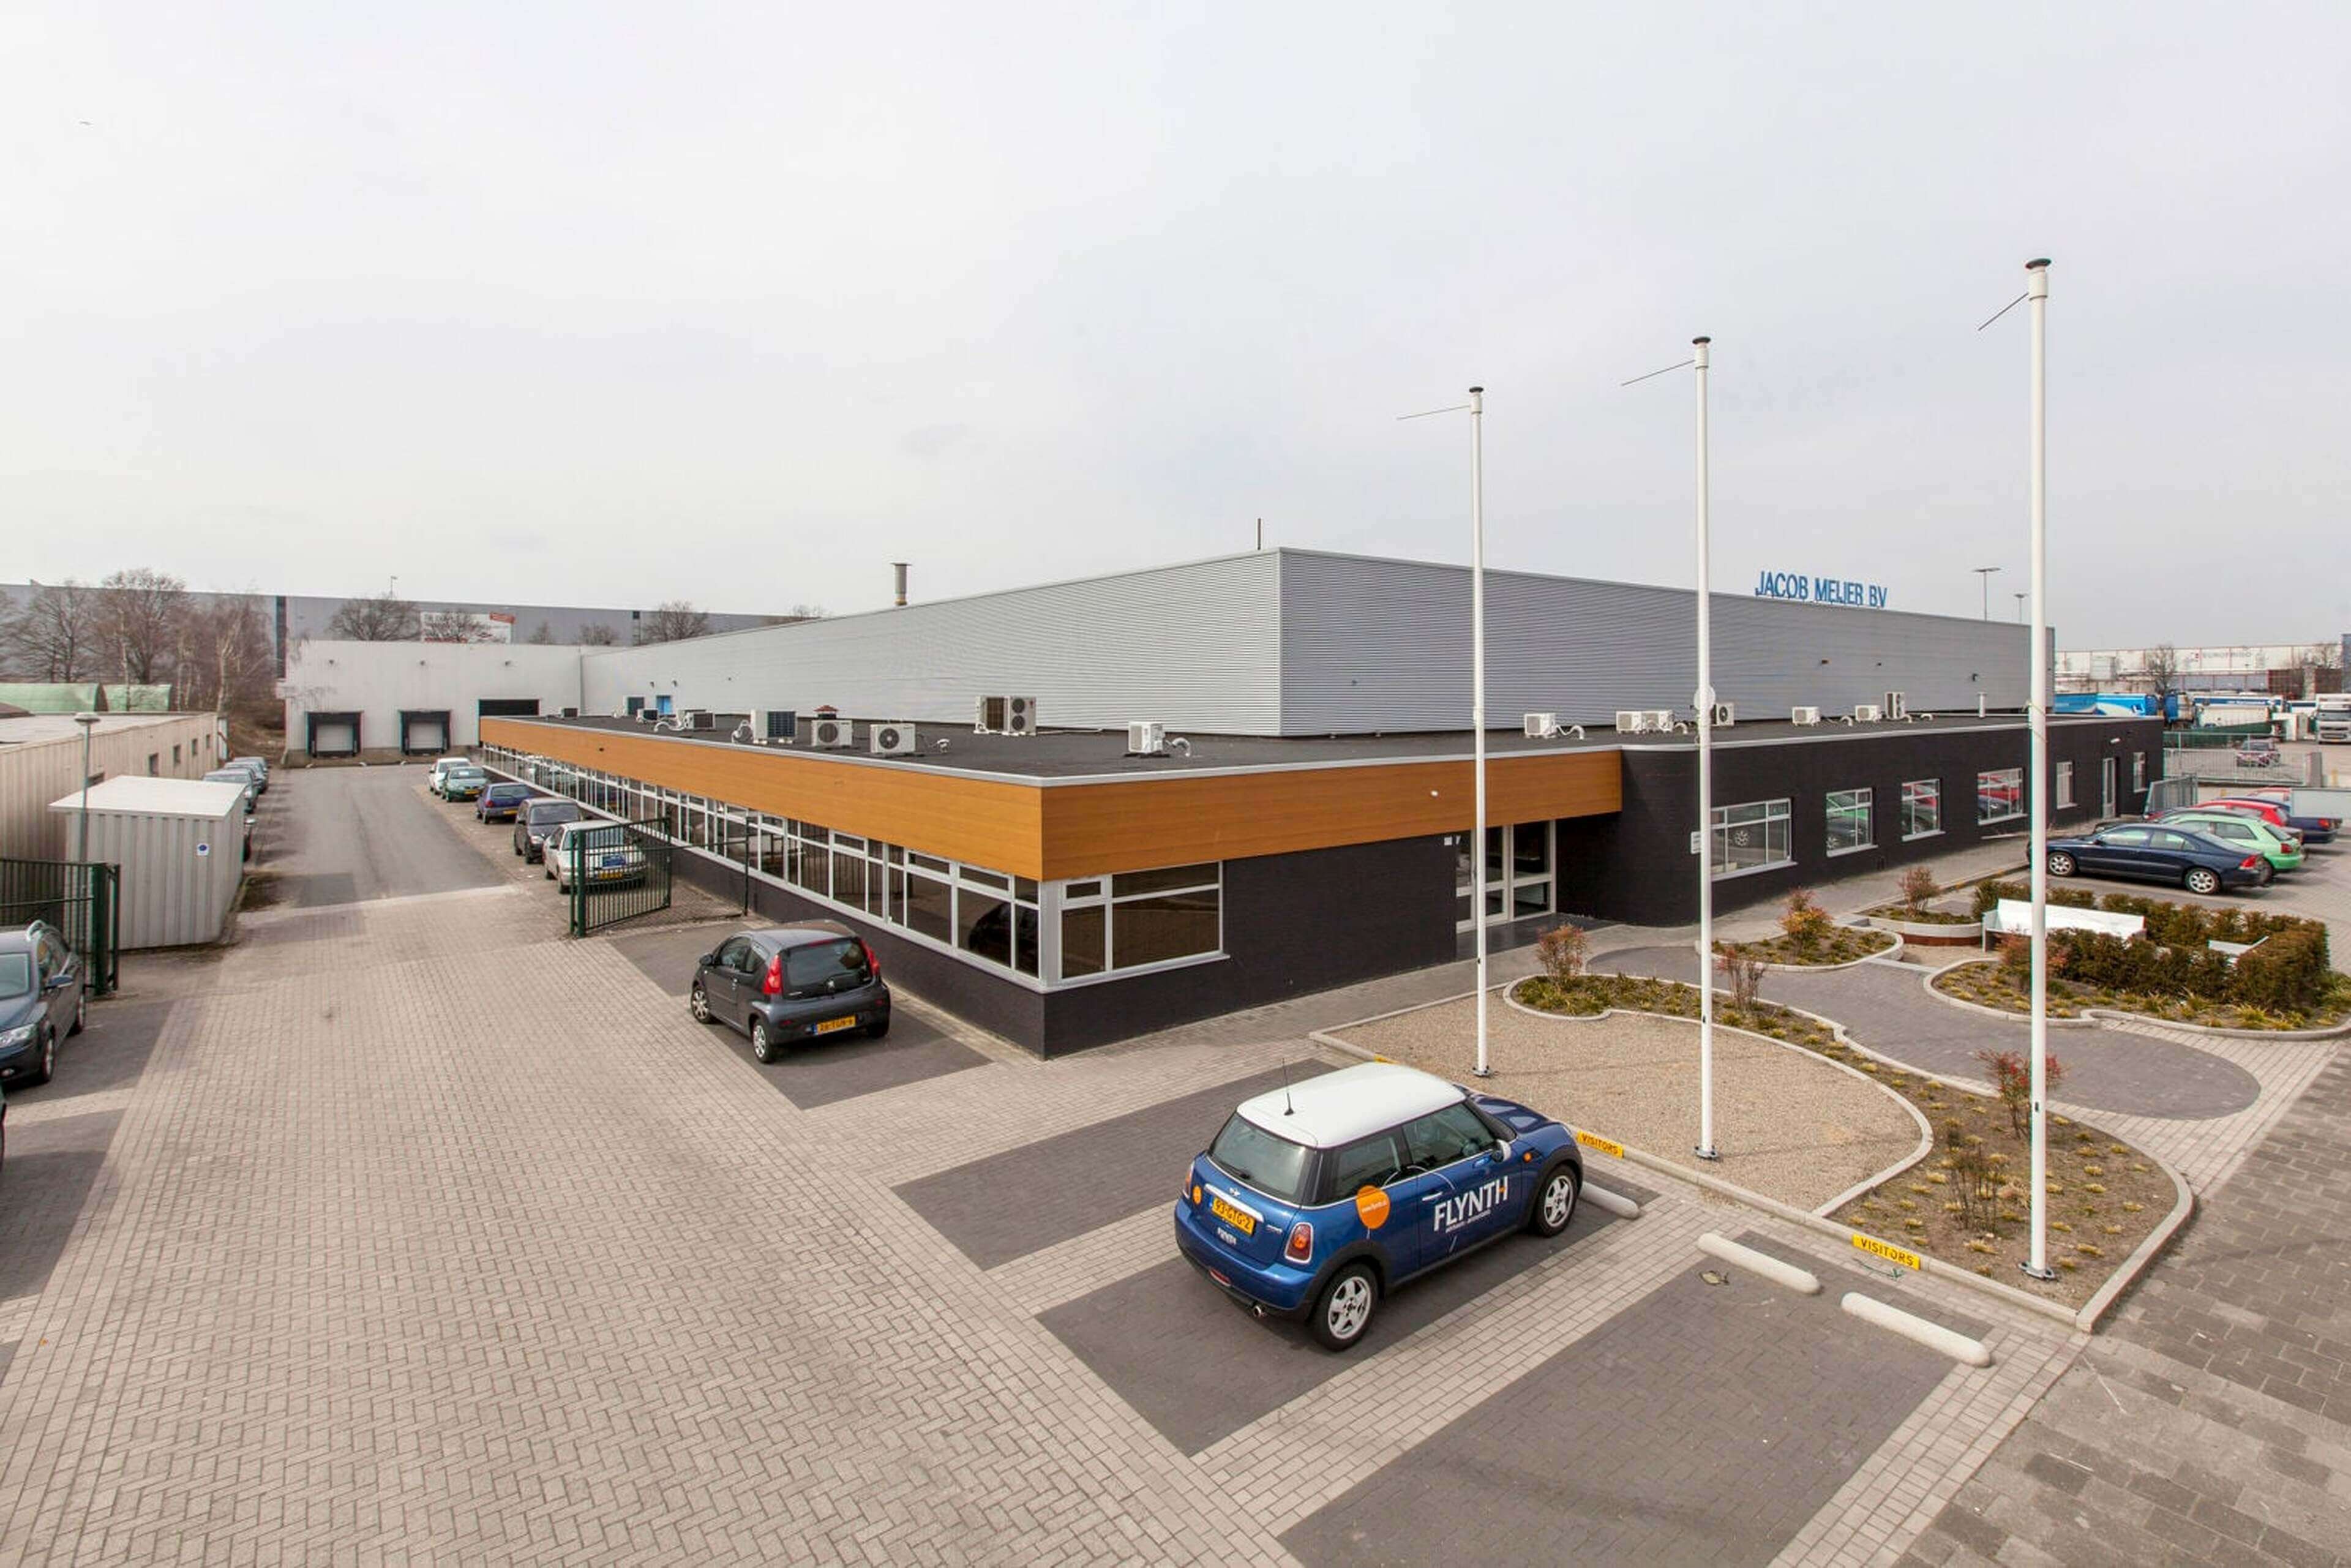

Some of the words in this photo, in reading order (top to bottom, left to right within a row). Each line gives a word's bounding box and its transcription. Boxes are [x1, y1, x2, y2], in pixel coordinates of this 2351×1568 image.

[1755, 571, 1809, 599] JACOB
[1815, 577, 1864, 606] MEIJER
[1869, 585, 1888, 608] BV
[1581, 1133, 1618, 1155] VISITORS
[1433, 1175, 1509, 1232] FLYNTH
[1861, 1237, 1914, 1266] VISITORS
